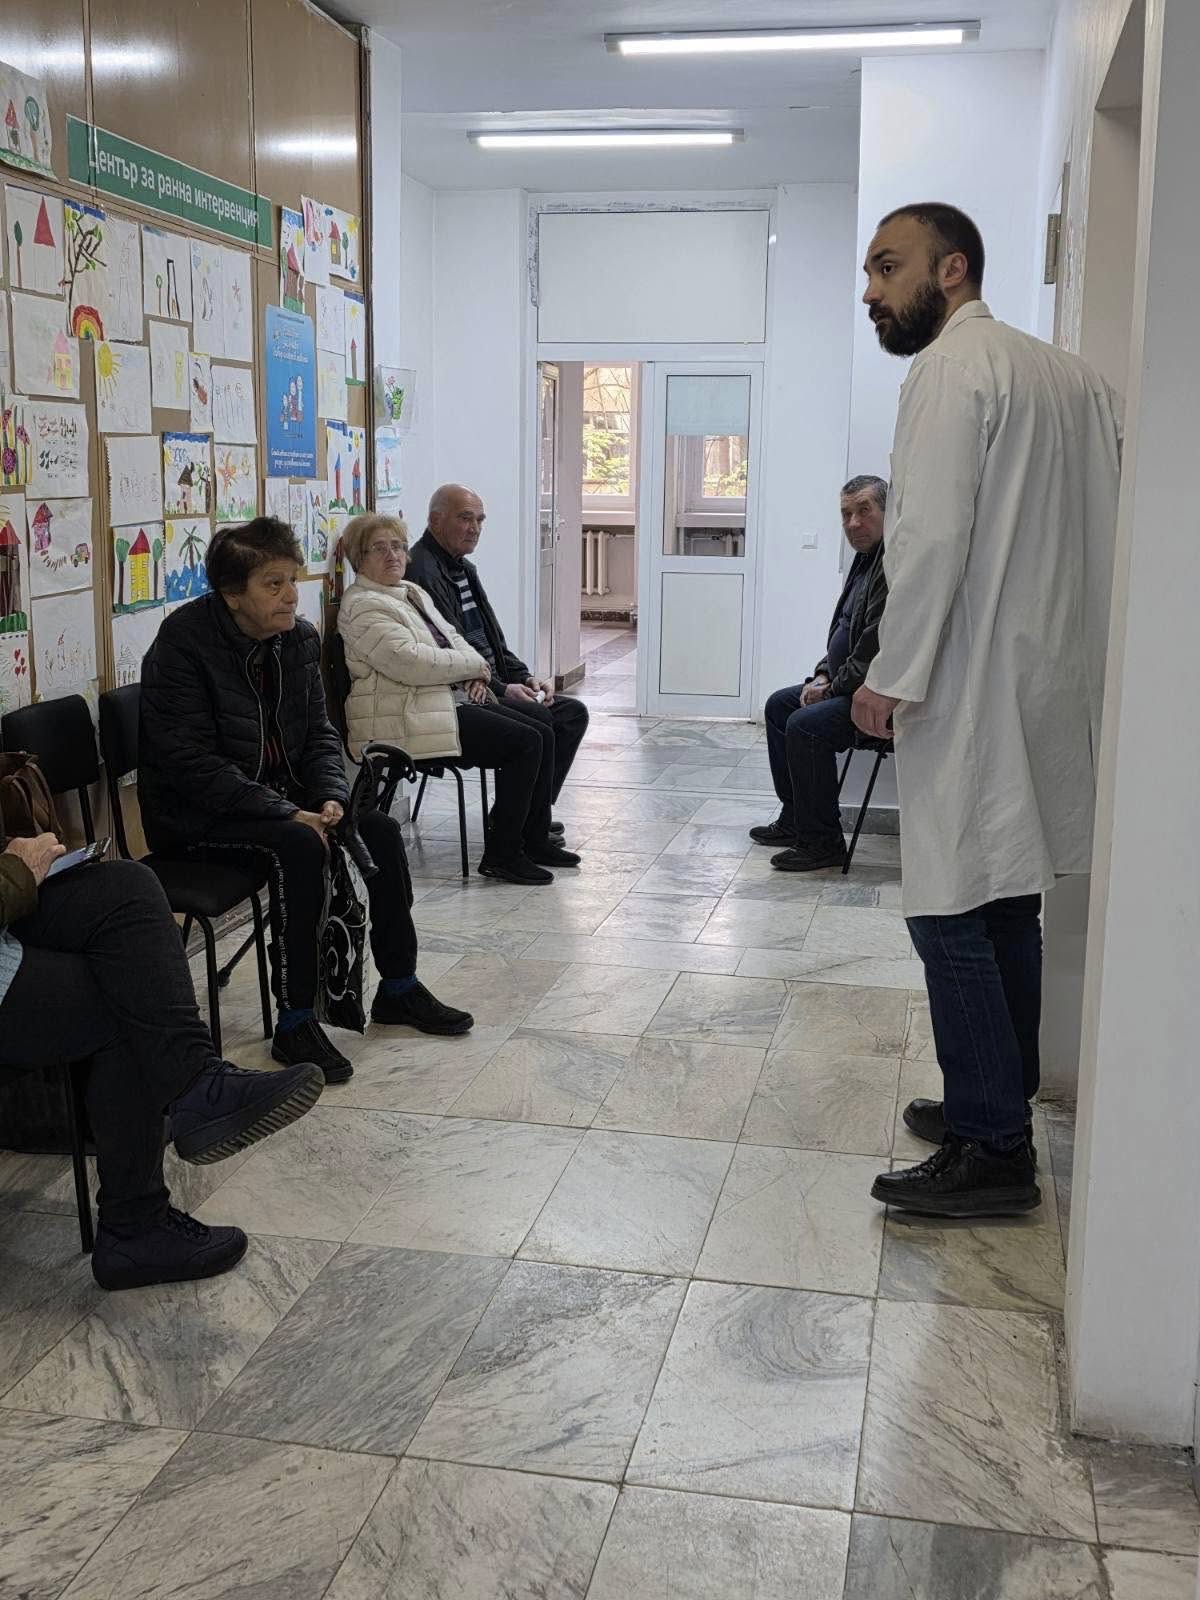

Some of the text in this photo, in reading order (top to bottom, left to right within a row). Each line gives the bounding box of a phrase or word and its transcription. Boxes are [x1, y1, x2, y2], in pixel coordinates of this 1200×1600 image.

[89, 128, 260, 229] Център за ранна интервенция
